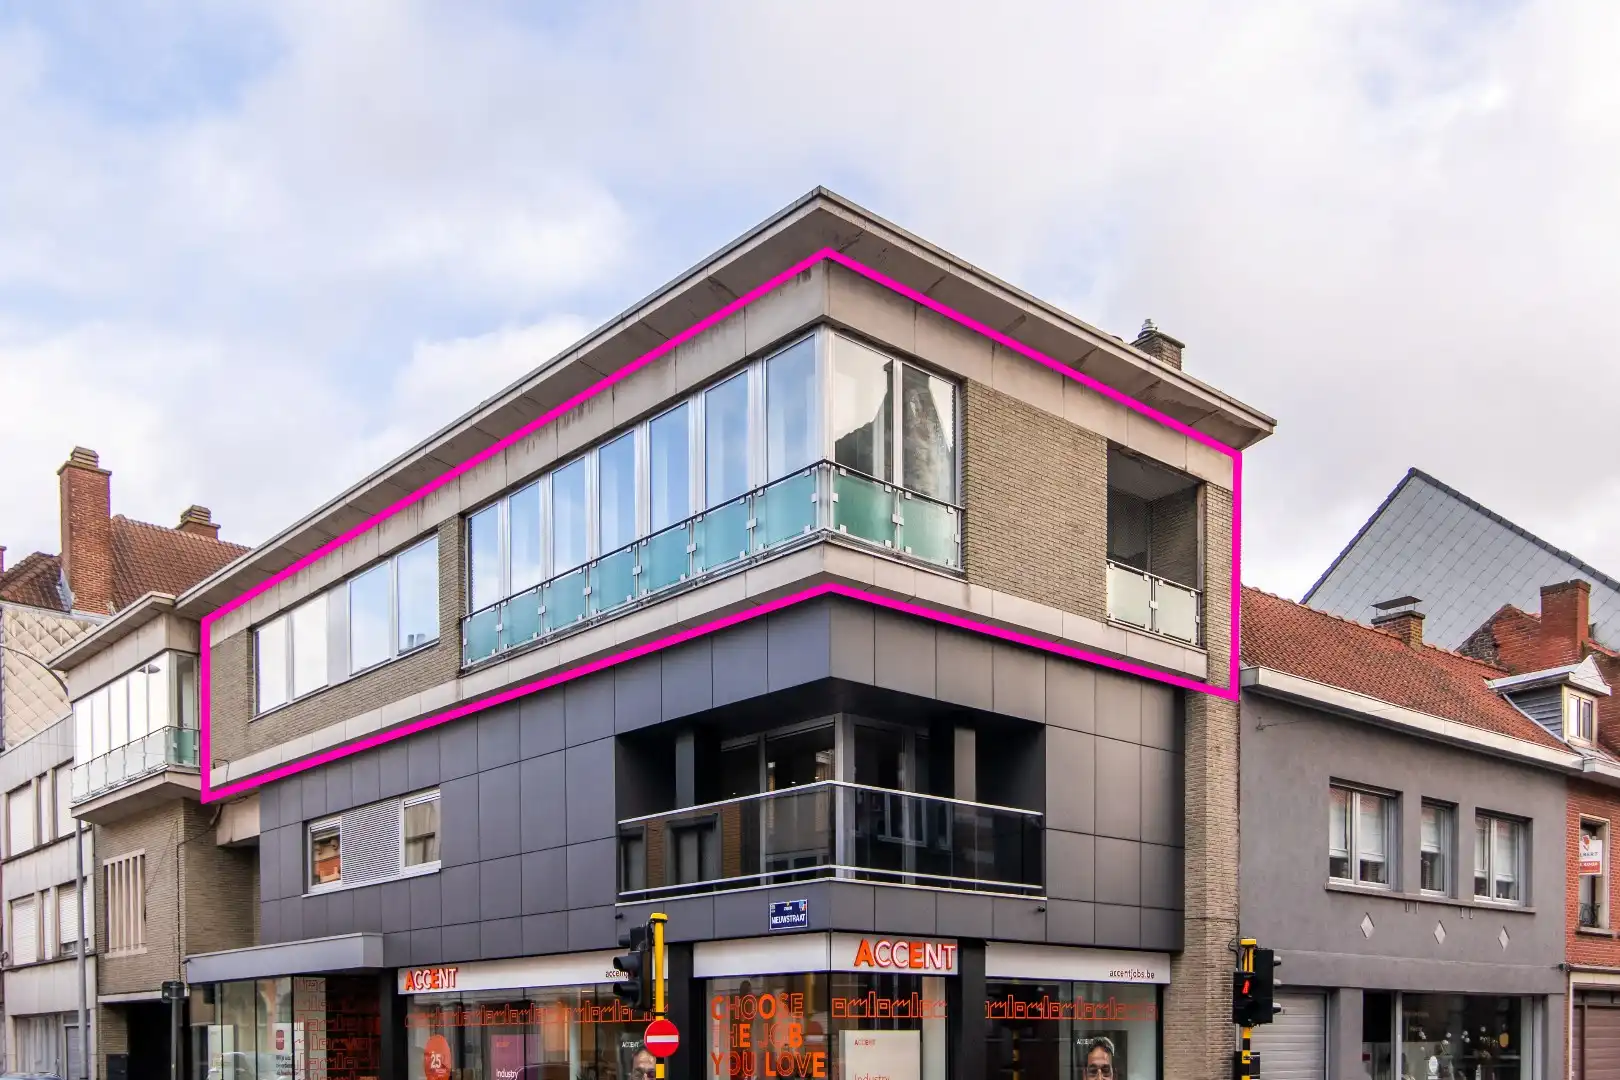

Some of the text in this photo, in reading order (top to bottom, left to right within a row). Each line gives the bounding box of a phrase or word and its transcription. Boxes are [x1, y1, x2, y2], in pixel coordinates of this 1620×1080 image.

[772, 914, 805, 924] NIEUWSTRAAT
[854, 938, 957, 969] ACCENT
[405, 967, 458, 991] ACCENT
[1109, 969, 1155, 980] accentjobs.be
[711, 992, 804, 1020] CHOOSE
[758, 1022, 803, 1048] JOB
[430, 1053, 442, 1069] 25
[711, 1051, 826, 1077] YOU LOVE
[496, 1068, 519, 1079] Industry
